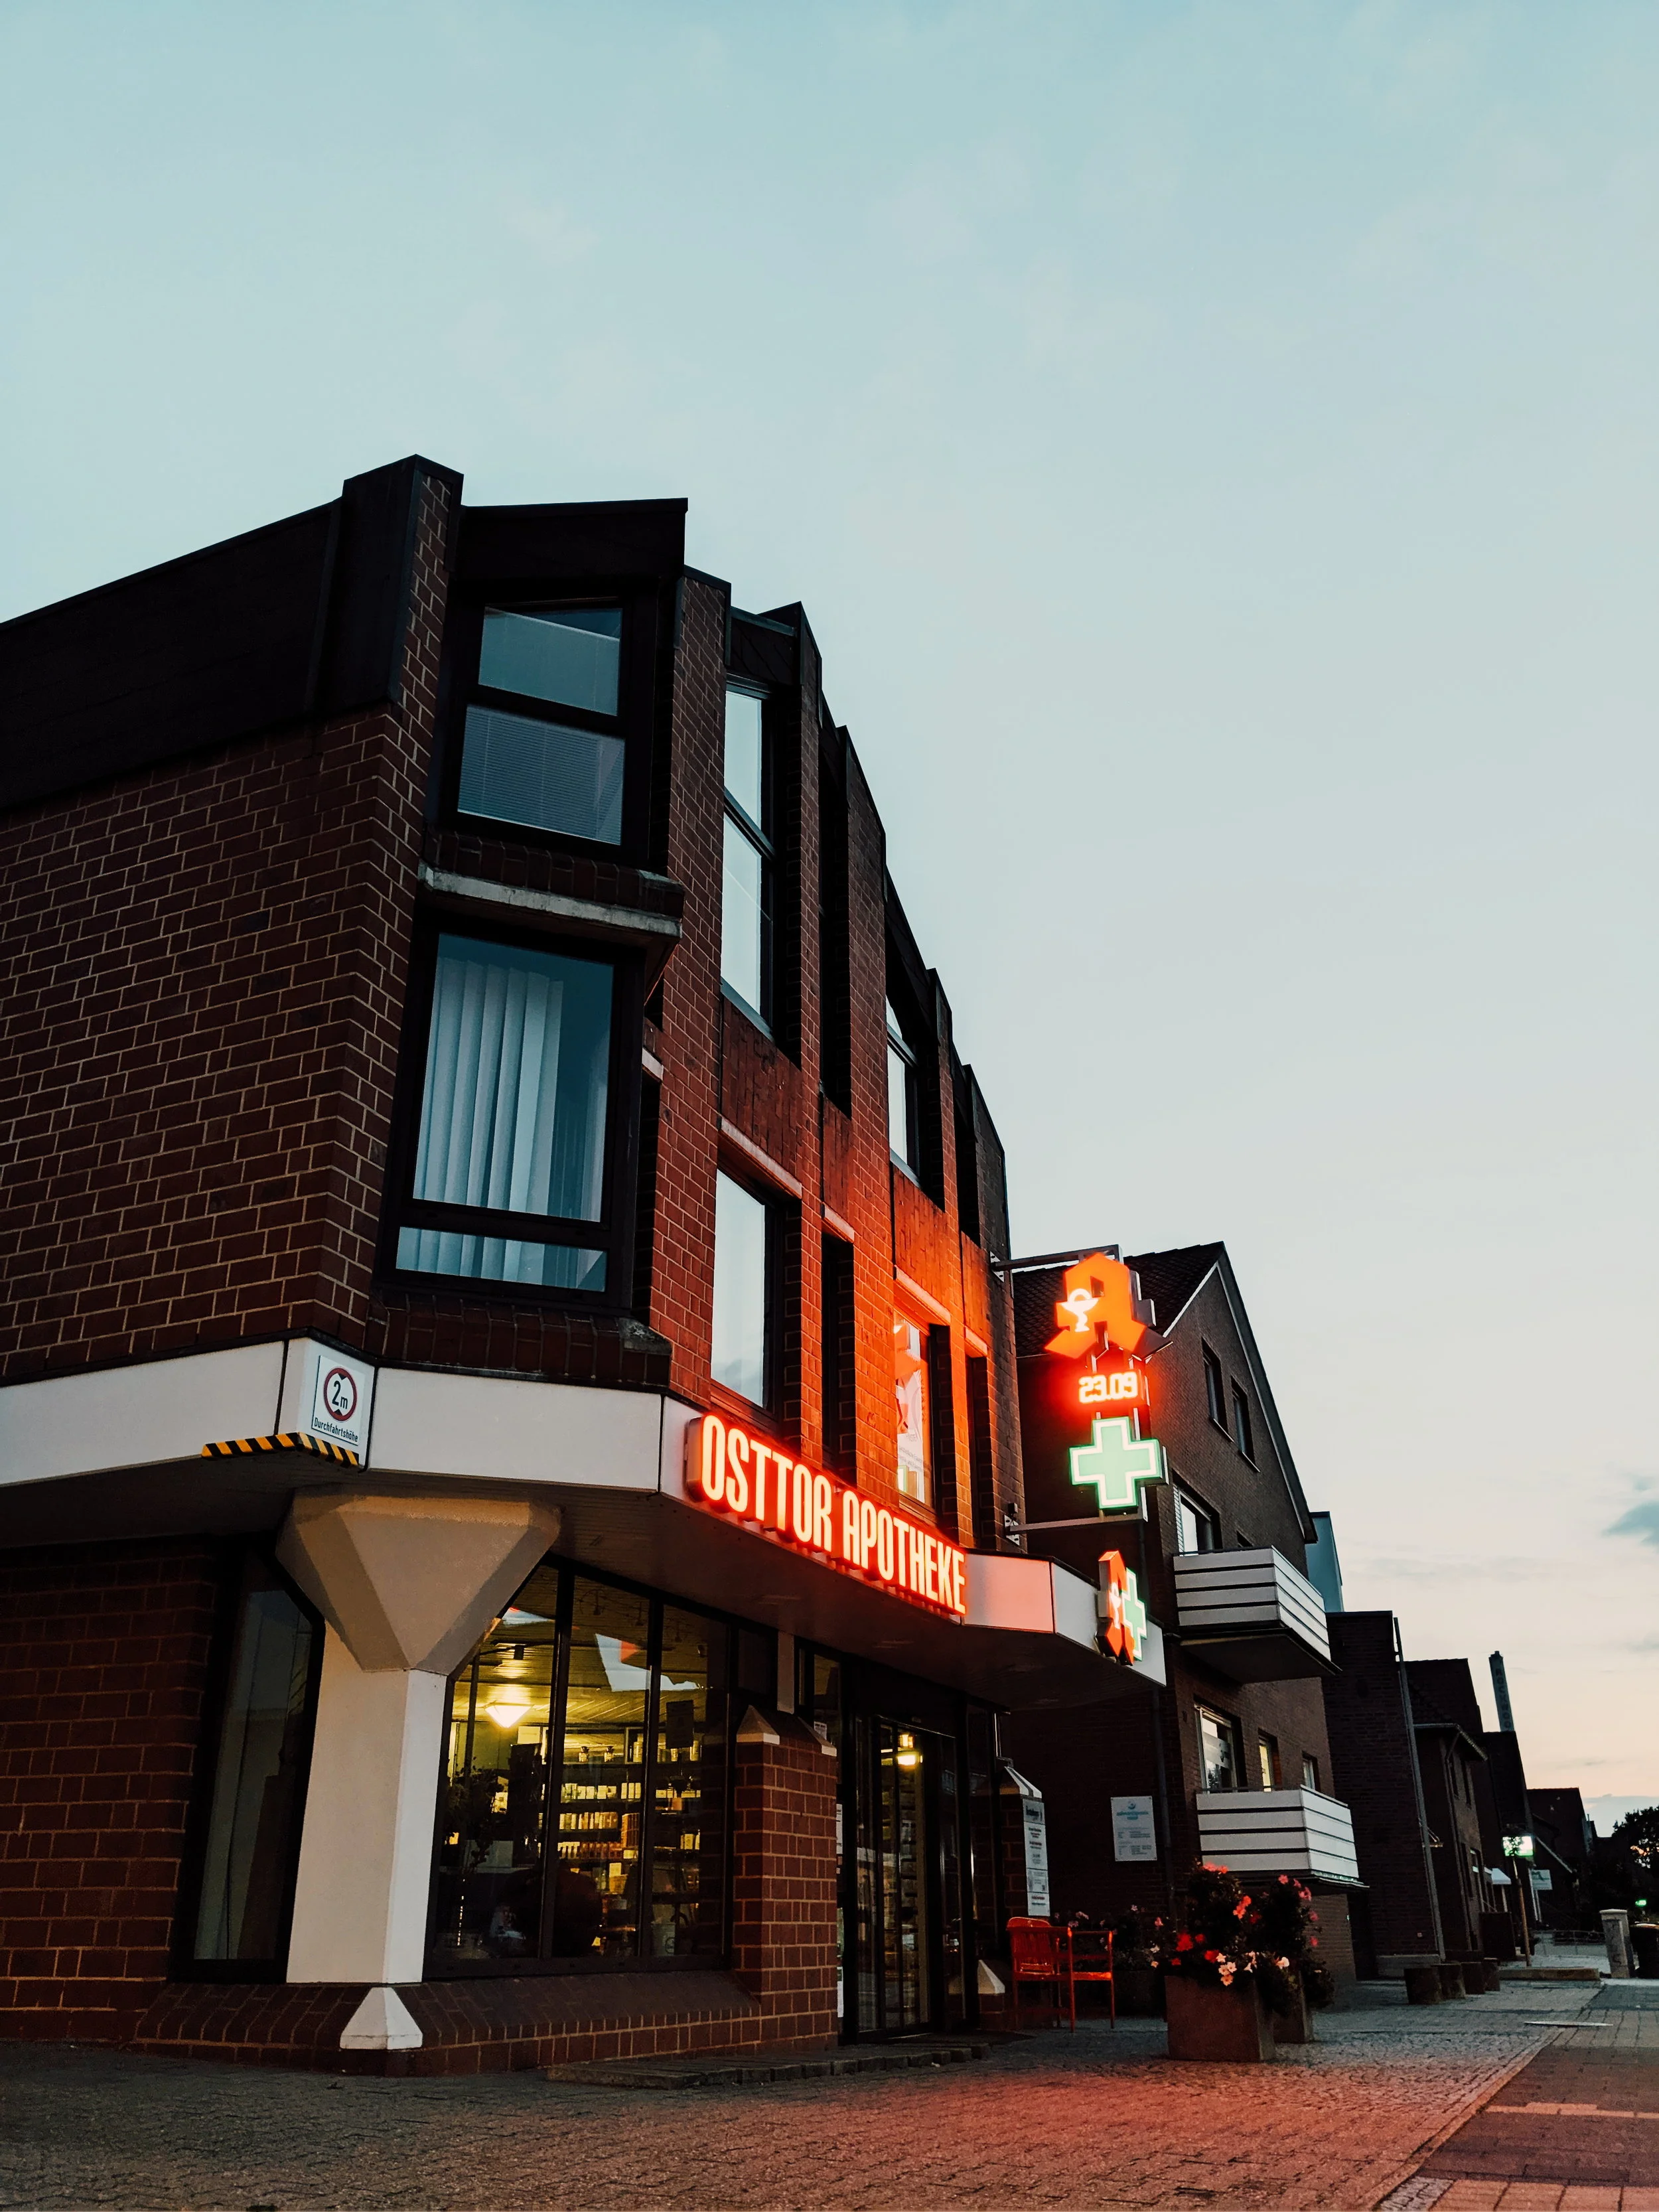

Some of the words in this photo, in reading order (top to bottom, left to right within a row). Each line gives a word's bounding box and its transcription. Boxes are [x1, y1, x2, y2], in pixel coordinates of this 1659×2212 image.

[314, 1418, 358, 1441] Durchfahrtshöhe
[701, 1414, 832, 1553] OSTTOR
[842, 1490, 966, 1615] APOTHEKE
